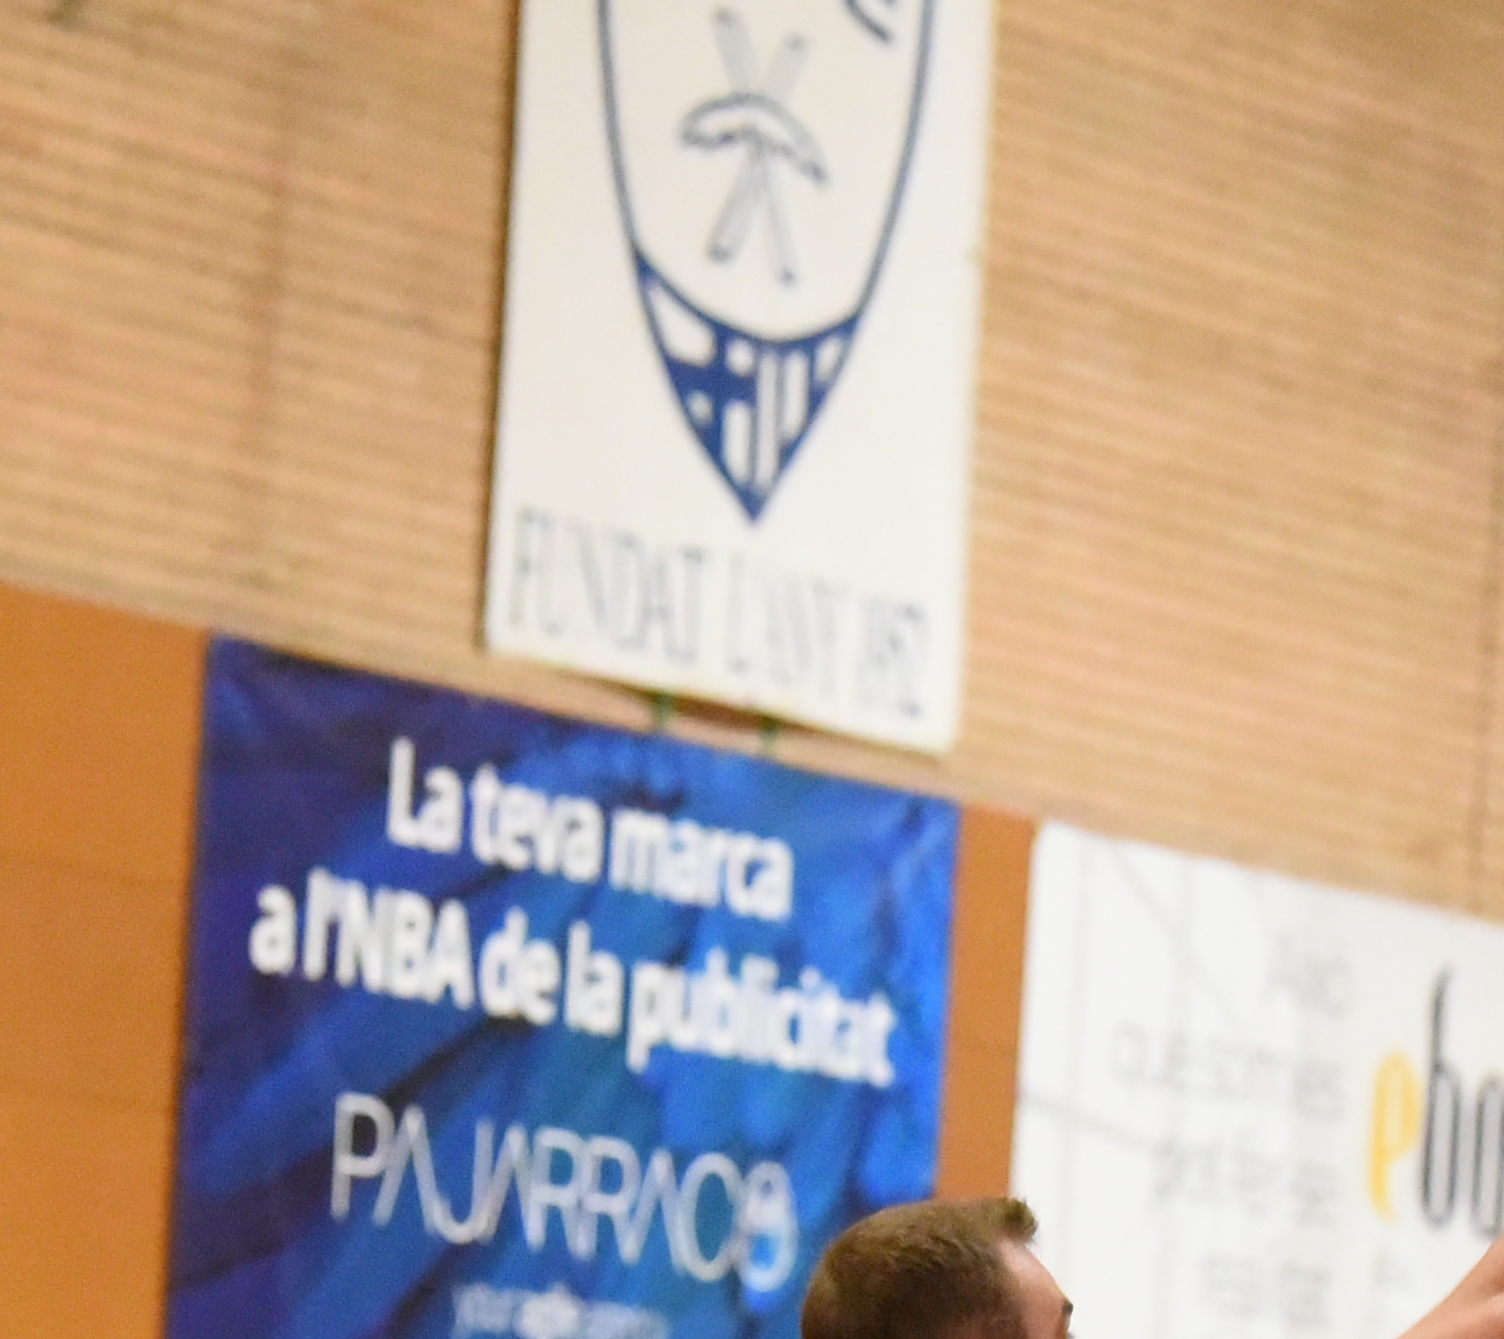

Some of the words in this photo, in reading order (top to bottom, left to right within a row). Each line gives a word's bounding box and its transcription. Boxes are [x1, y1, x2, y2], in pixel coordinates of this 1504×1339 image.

[387, 736, 463, 853] La
[470, 765, 604, 882] teva
[611, 808, 793, 921] marca
[249, 885, 296, 974] a
[304, 868, 474, 1009] l'NBA
[480, 906, 560, 1026] de
[564, 921, 623, 1036] la
[627, 946, 896, 1088] publicitat
